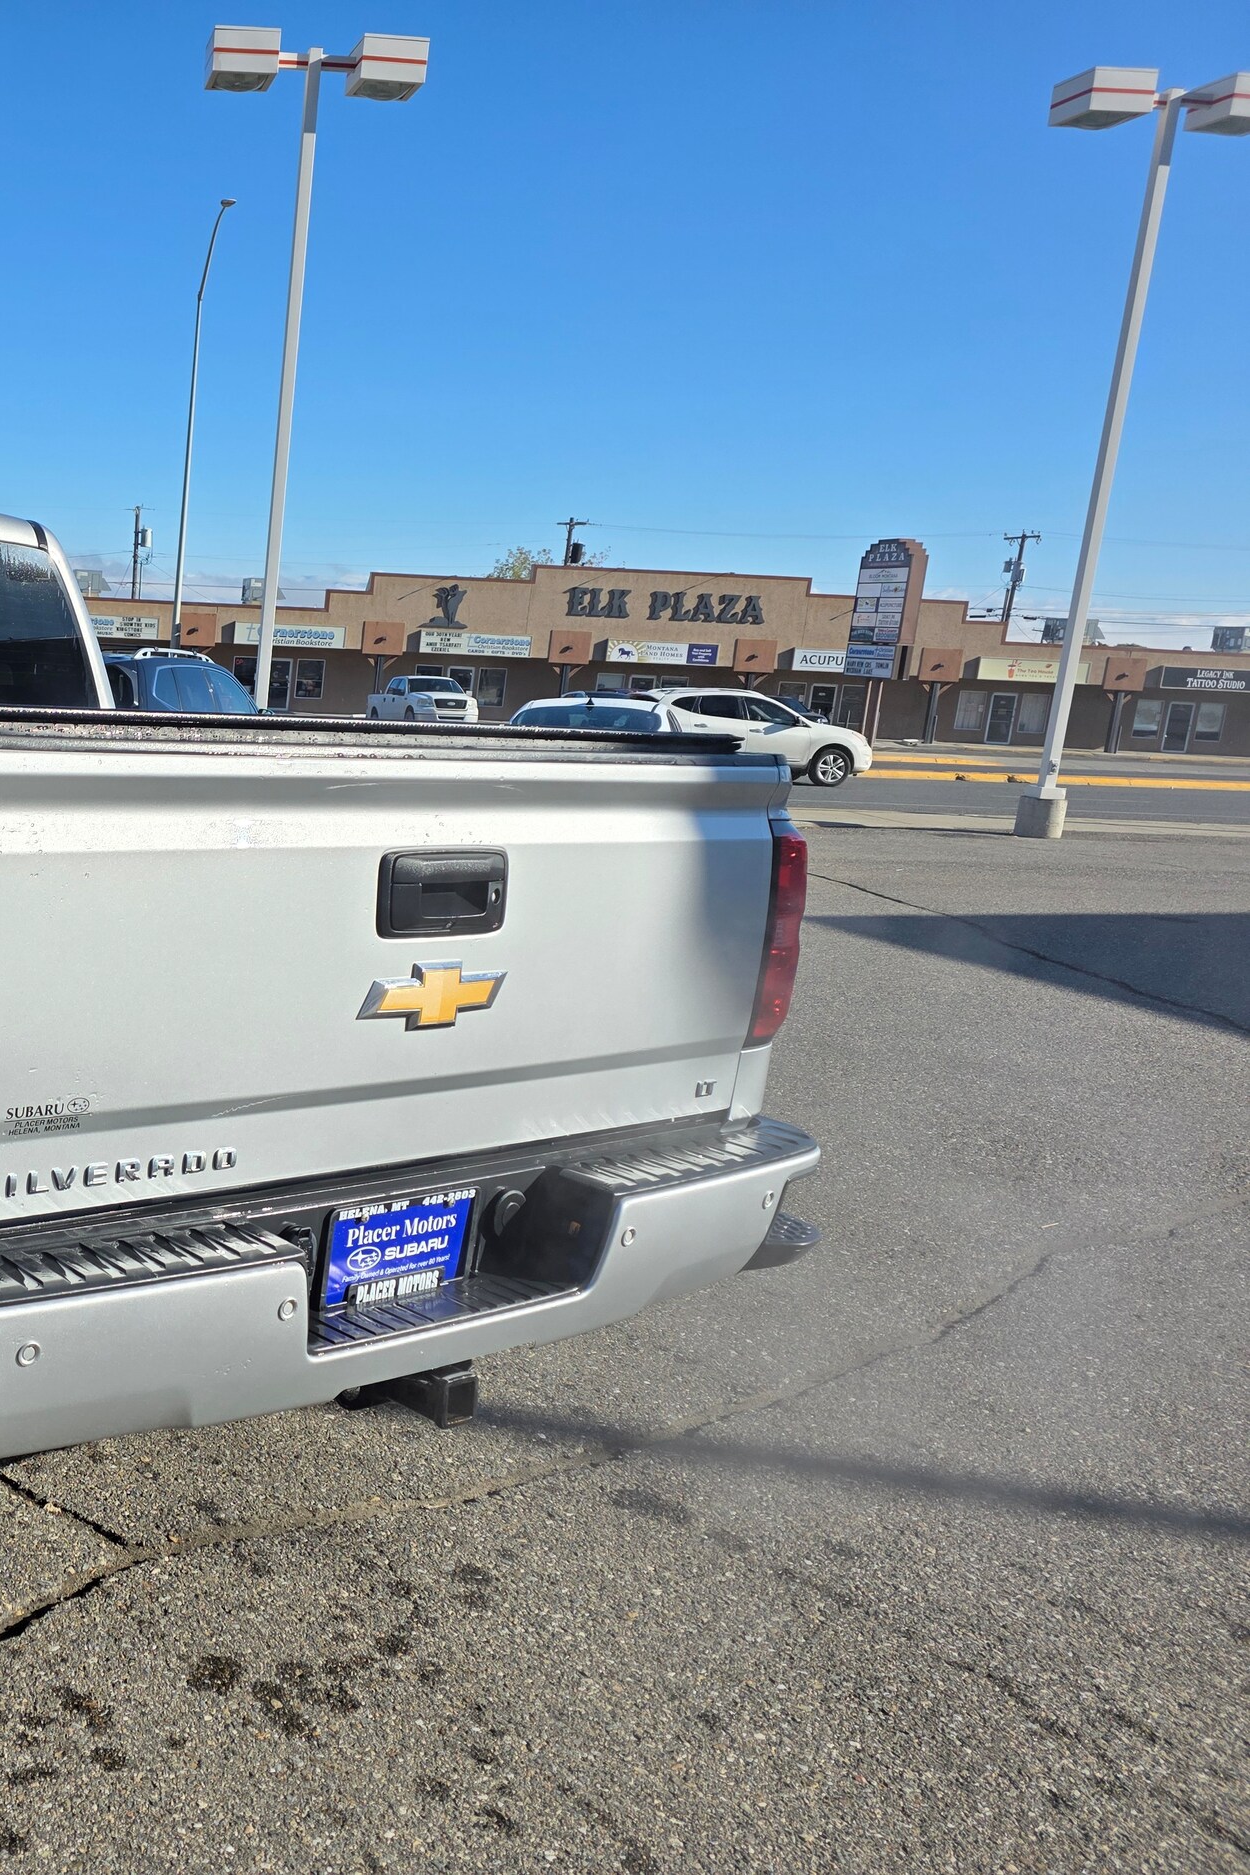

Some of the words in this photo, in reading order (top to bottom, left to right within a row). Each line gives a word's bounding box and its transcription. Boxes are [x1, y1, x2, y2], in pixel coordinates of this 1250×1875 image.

[879, 543, 898, 552] ELK
[868, 552, 905, 562] PLAZA
[564, 587, 632, 618] ELK
[647, 591, 766, 625] PLAZA
[296, 639, 333, 647] Bookstore
[473, 635, 531, 646] Cornerstone
[800, 655, 844, 666] ACUPU
[1196, 669, 1221, 678] LEGACY
[1222, 670, 1234, 679] INK
[1187, 678, 1217, 688] TATTOO
[1217, 679, 1246, 689] STUDIO
[695, 1080, 717, 1098] LT
[5, 1103, 65, 1120] SUBARU
[8, 1127, 41, 1136] HELENA,
[44, 1122, 80, 1132] MONTANA
[14, 1120, 45, 1129] PLACER
[46, 1116, 78, 1124] MOTORS
[338, 1205, 388, 1221] HELENA,
[390, 1201, 410, 1212] MT
[346, 1224, 400, 1247] Placer
[402, 1213, 457, 1237] Motors
[384, 1235, 449, 1260] SUBARU
[342, 1274, 359, 1283] Family
[360, 1271, 379, 1279] Owned
[356, 1279, 396, 1304] PLACER
[397, 1270, 440, 1296] MOTORS
